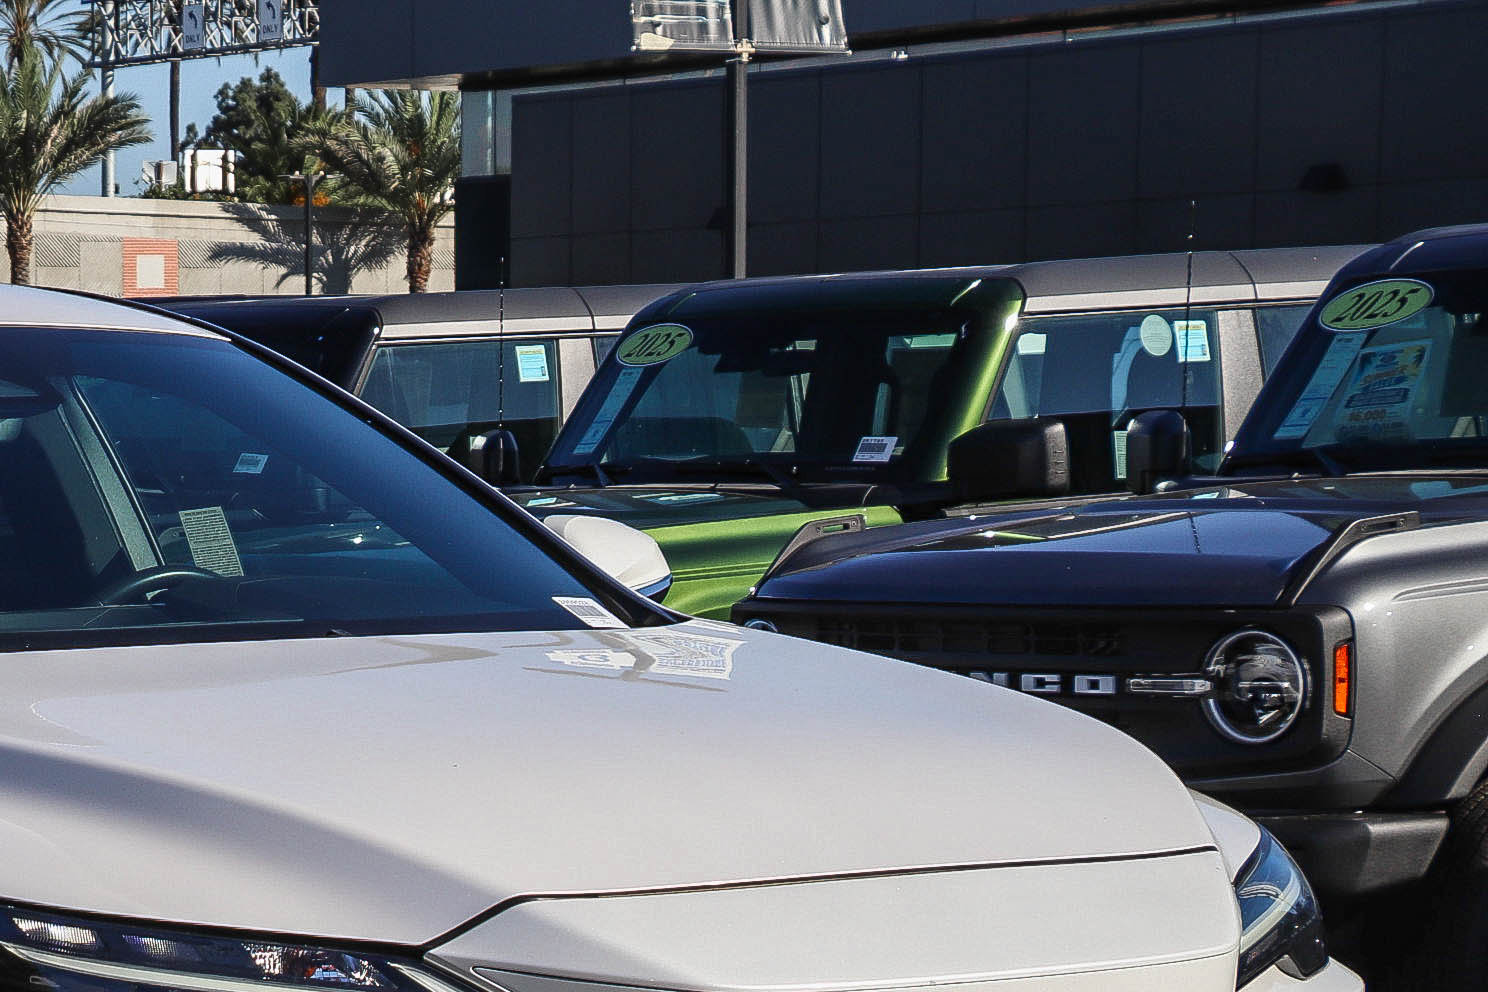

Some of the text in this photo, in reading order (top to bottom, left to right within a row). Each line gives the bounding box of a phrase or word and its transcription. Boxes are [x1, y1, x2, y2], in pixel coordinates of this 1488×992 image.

[185, 34, 201, 44] ONLY
[262, 23, 279, 34] ONLY
[1329, 286, 1424, 324] 2025
[622, 332, 687, 358] 2025
[968, 672, 1116, 694] NCO
